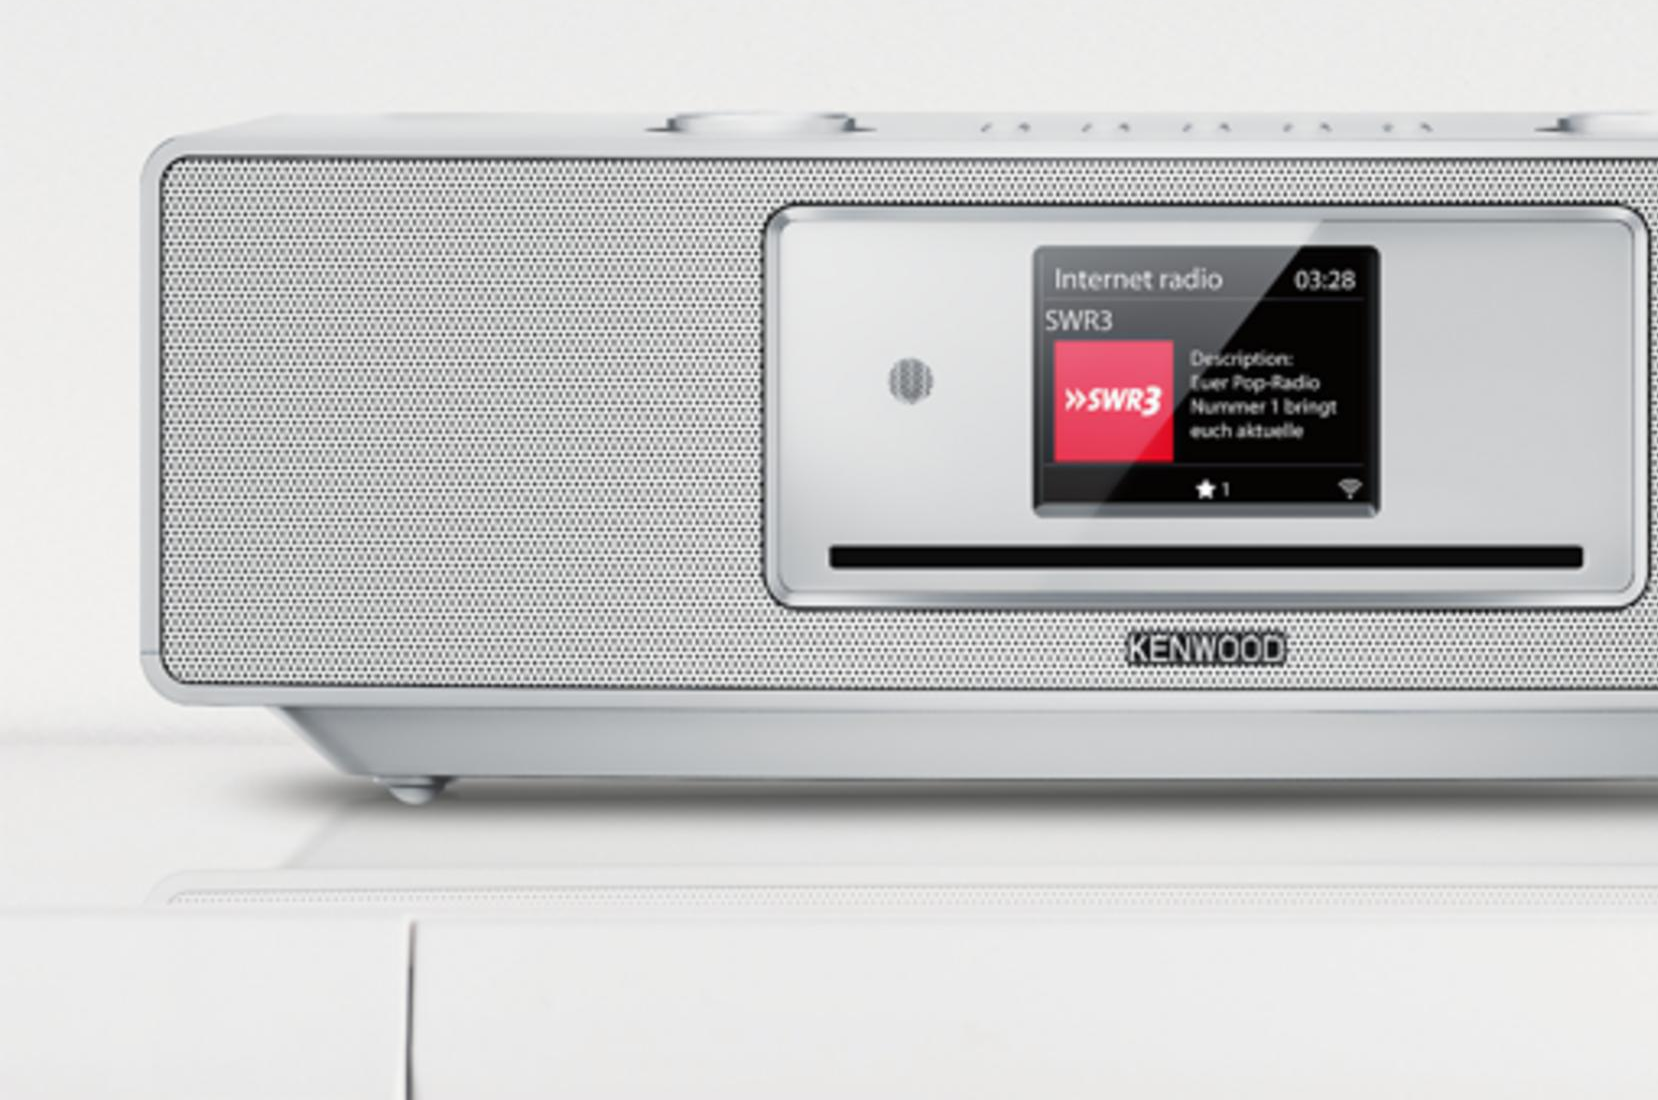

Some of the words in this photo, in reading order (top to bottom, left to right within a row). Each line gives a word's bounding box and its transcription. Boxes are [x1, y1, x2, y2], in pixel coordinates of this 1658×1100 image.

[1055, 268, 1153, 291] Internet
[1159, 267, 1223, 291] radio
[1294, 270, 1356, 291] 03:28
[1045, 309, 1113, 331] SWR3
[1190, 350, 1294, 369] Description:
[1190, 375, 1229, 391] Euer
[1232, 374, 1321, 393] Pop-Radio
[1190, 399, 1266, 416] Nummer
[1271, 399, 1279, 416] 1
[1284, 397, 1338, 418] bringt
[1189, 422, 1232, 439] euch
[1236, 422, 1304, 439] aktuelle
[1222, 482, 1231, 497] 1
[1128, 634, 1286, 662] KENWOOD
